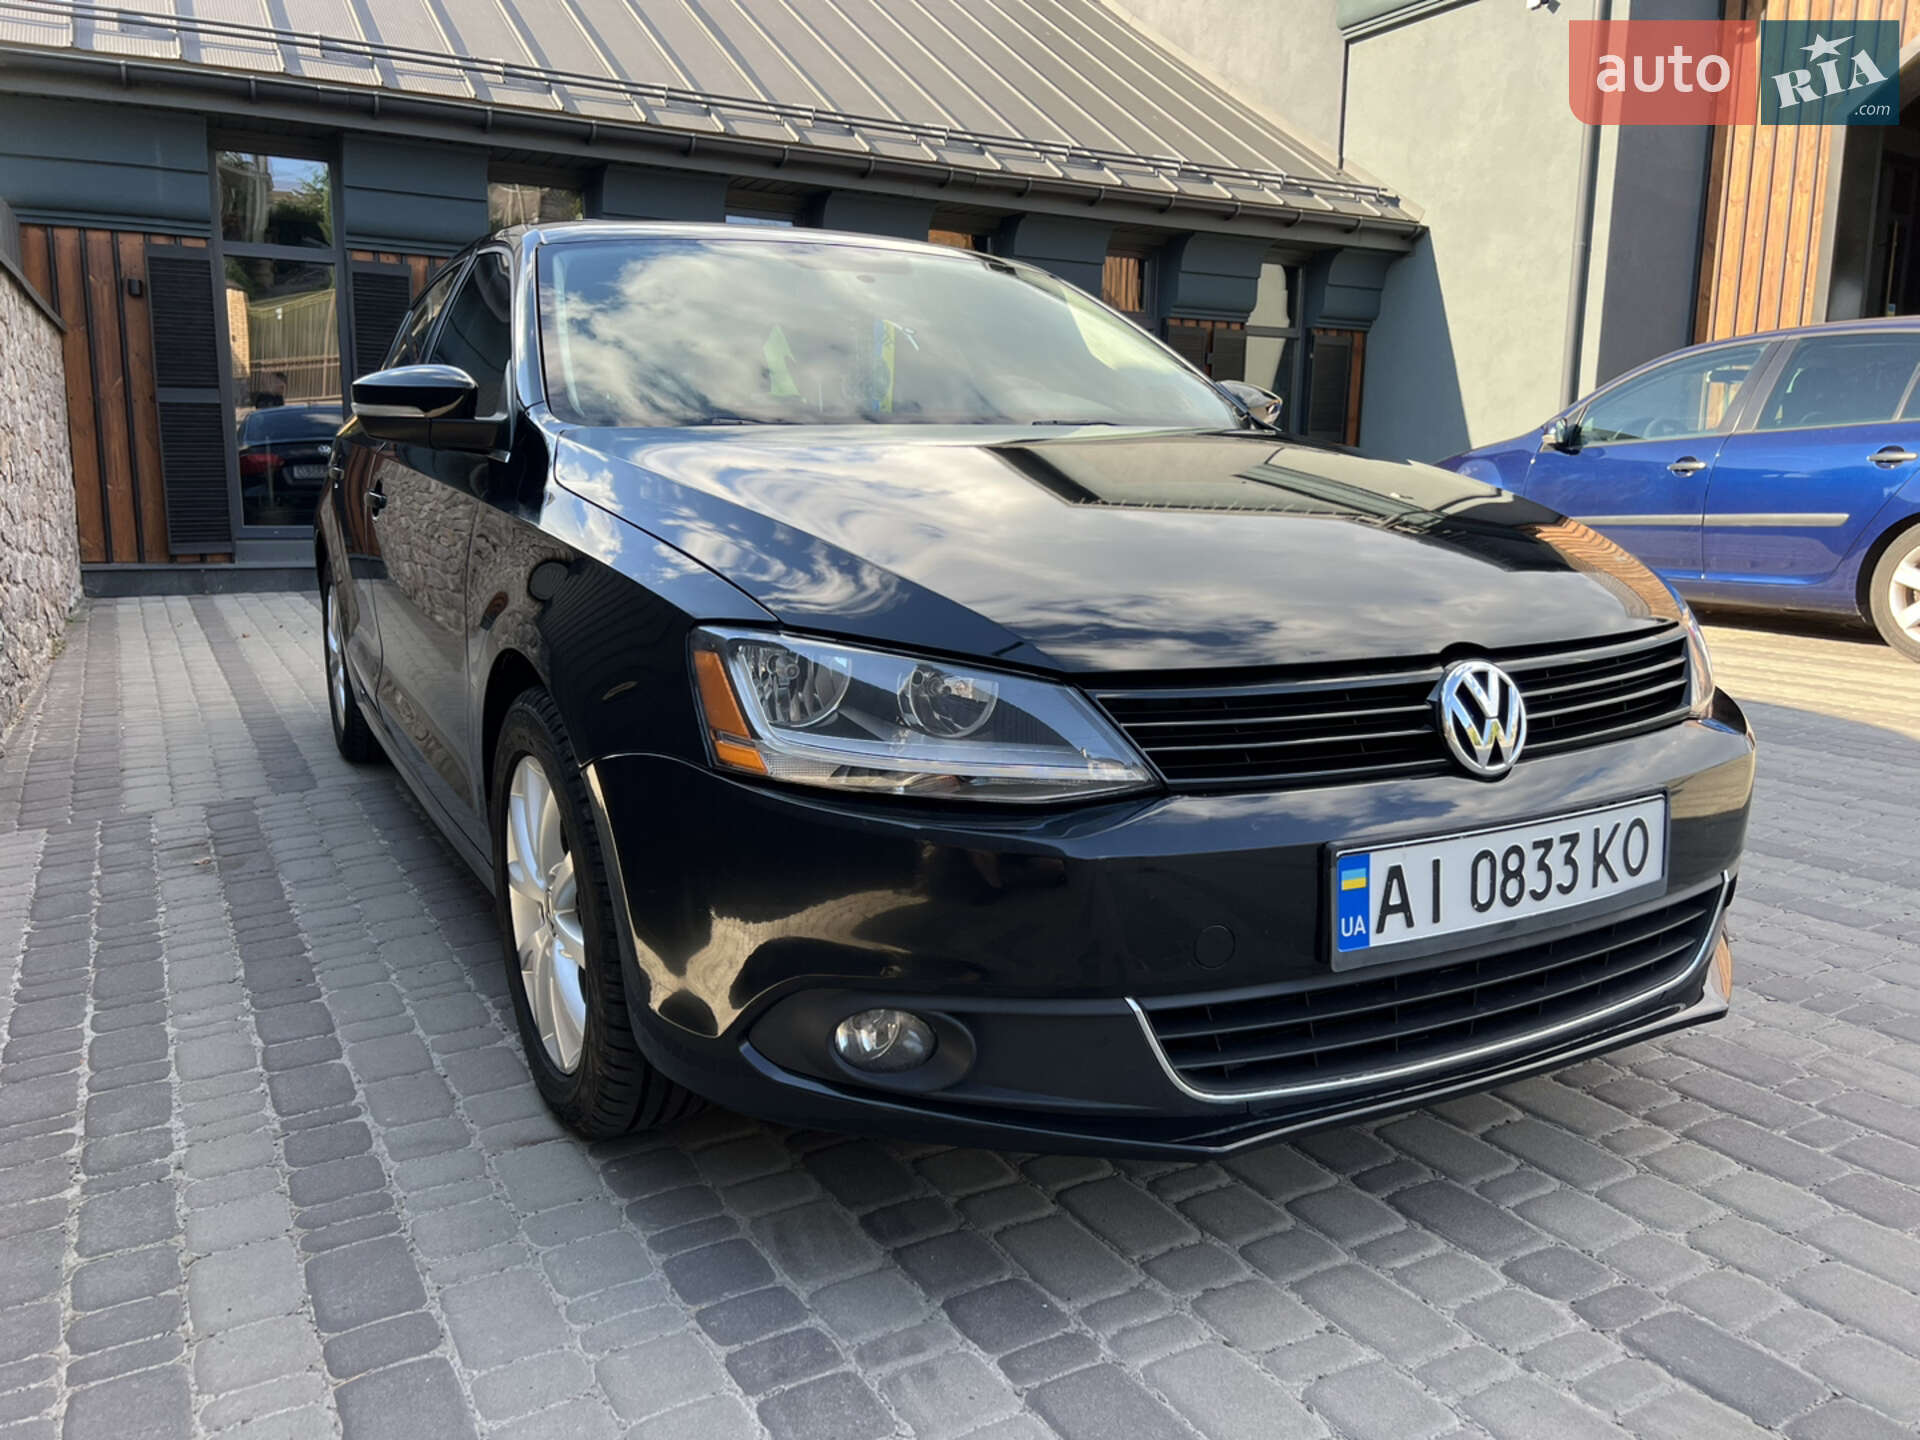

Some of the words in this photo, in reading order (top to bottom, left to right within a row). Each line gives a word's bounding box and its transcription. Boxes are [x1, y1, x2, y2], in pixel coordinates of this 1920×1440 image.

[1375, 858, 1441, 934] AI
[1471, 832, 1580, 913] 0833
[1592, 817, 1649, 888] KO
[1341, 915, 1366, 937] UA
